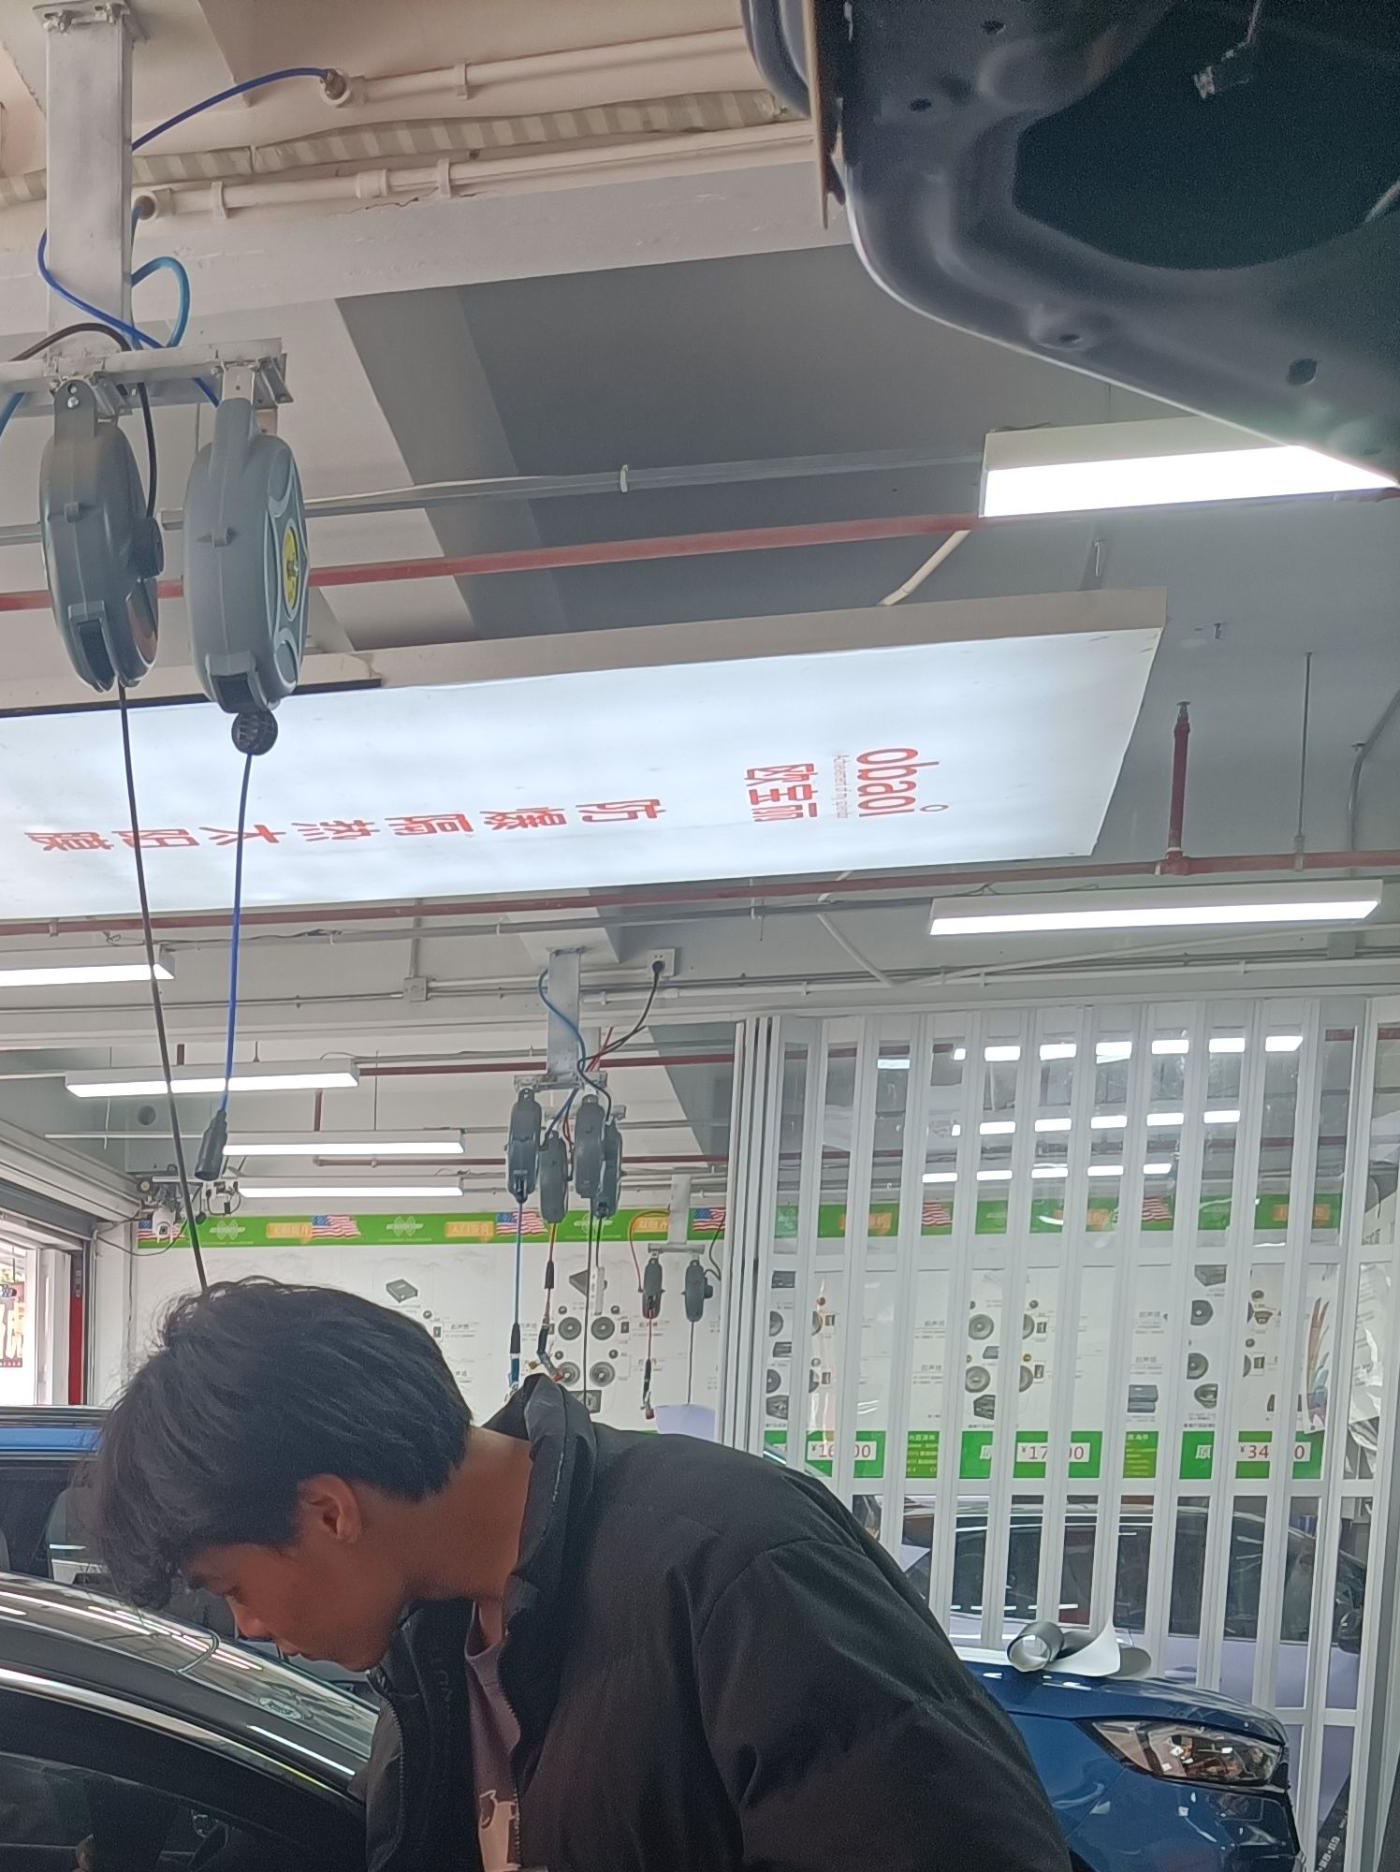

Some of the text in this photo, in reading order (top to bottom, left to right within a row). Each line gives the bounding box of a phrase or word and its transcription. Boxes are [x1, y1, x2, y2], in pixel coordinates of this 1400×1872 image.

[744, 763, 818, 822] 欧宝丽
[24, 798, 668, 851] 防爆隔热太阳膜
